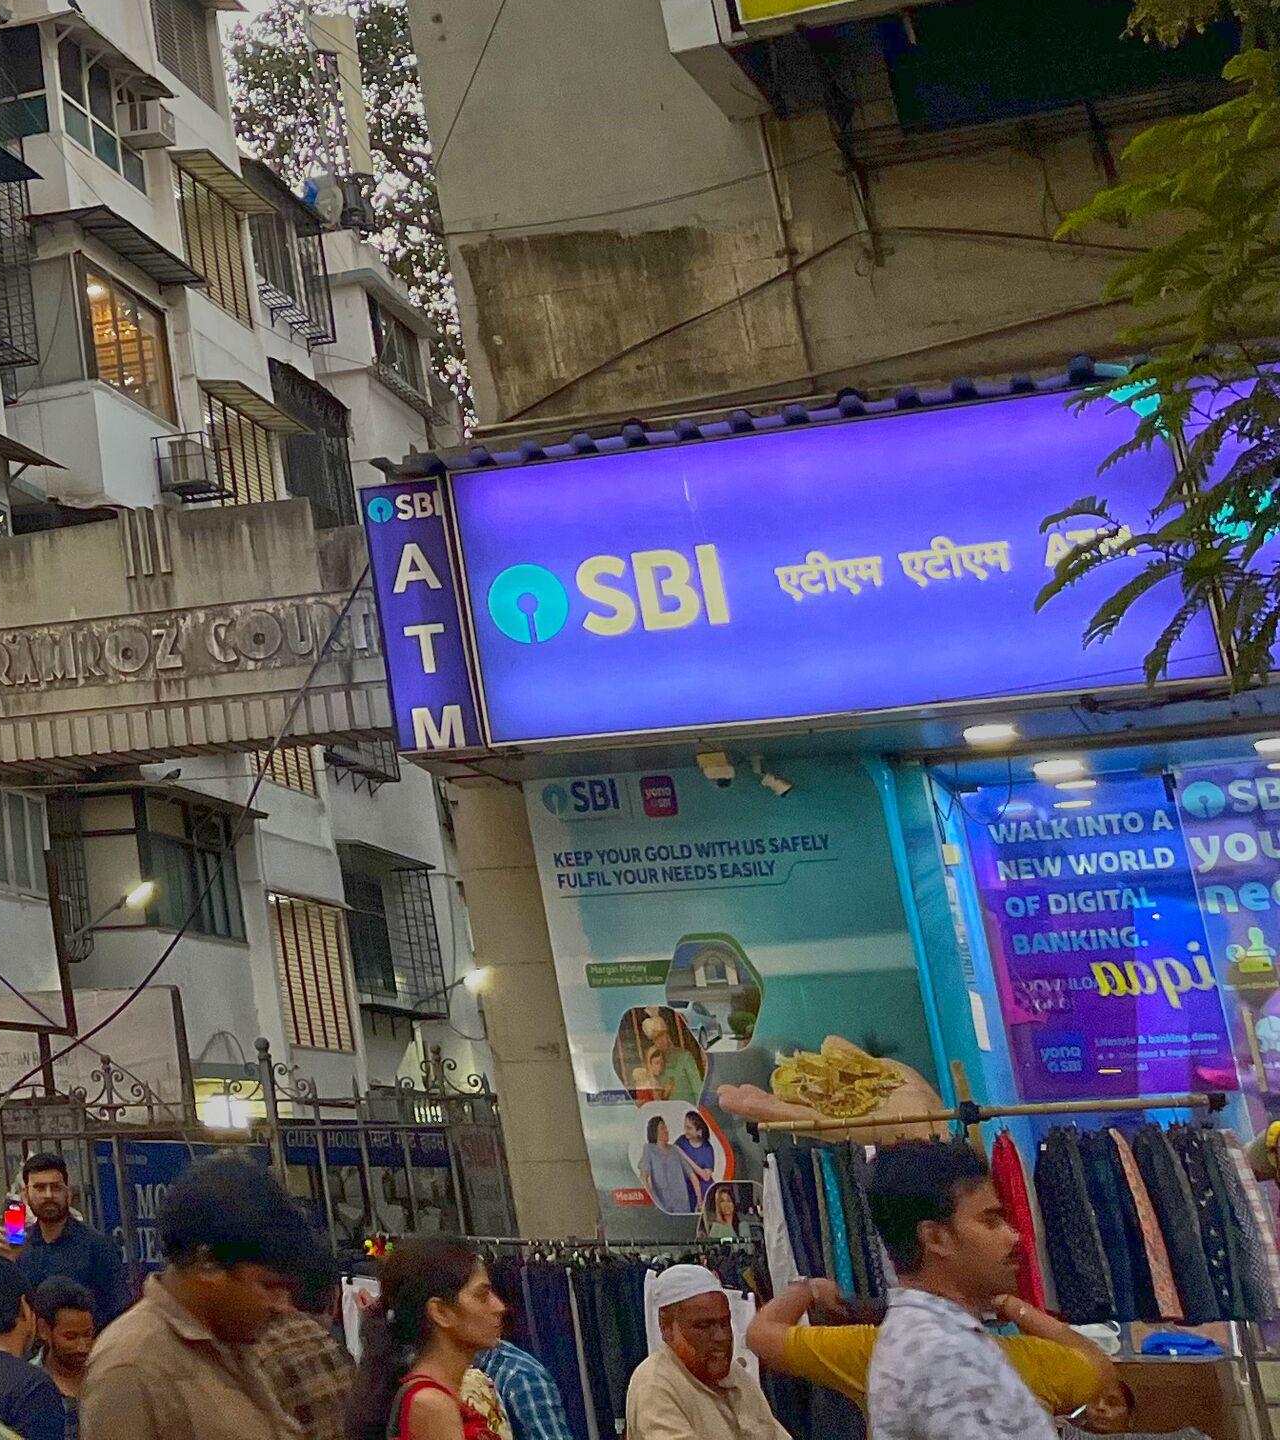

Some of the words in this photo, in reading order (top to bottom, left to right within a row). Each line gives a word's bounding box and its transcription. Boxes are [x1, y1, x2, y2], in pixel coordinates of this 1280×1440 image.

[776, 548, 883, 603] एटीएम
[898, 533, 1009, 591] एटीएम
[575, 543, 730, 637] SBI
[570, 778, 620, 812] SBI
[989, 817, 1075, 844] WALK
[1078, 812, 1144, 838] INTO
[1153, 810, 1174, 832] A
[553, 851, 593, 868] KEEP
[596, 847, 642, 866] YOUR
[645, 844, 690, 861] GOLD
[694, 841, 740, 859] WITH
[743, 838, 765, 855] US
[768, 834, 830, 854] SAFELY
[997, 855, 1061, 881] NEW
[1068, 846, 1175, 875] WORLD
[557, 870, 612, 889] FULFIL
[614, 868, 659, 886] YOUR
[663, 863, 717, 883] NEEDS
[720, 860, 776, 879] EASILY
[1005, 893, 1041, 918] OF
[1048, 886, 1156, 915] DIGITAL
[1012, 926, 1149, 955] BANKING.
[616, 1190, 644, 1202] Health
